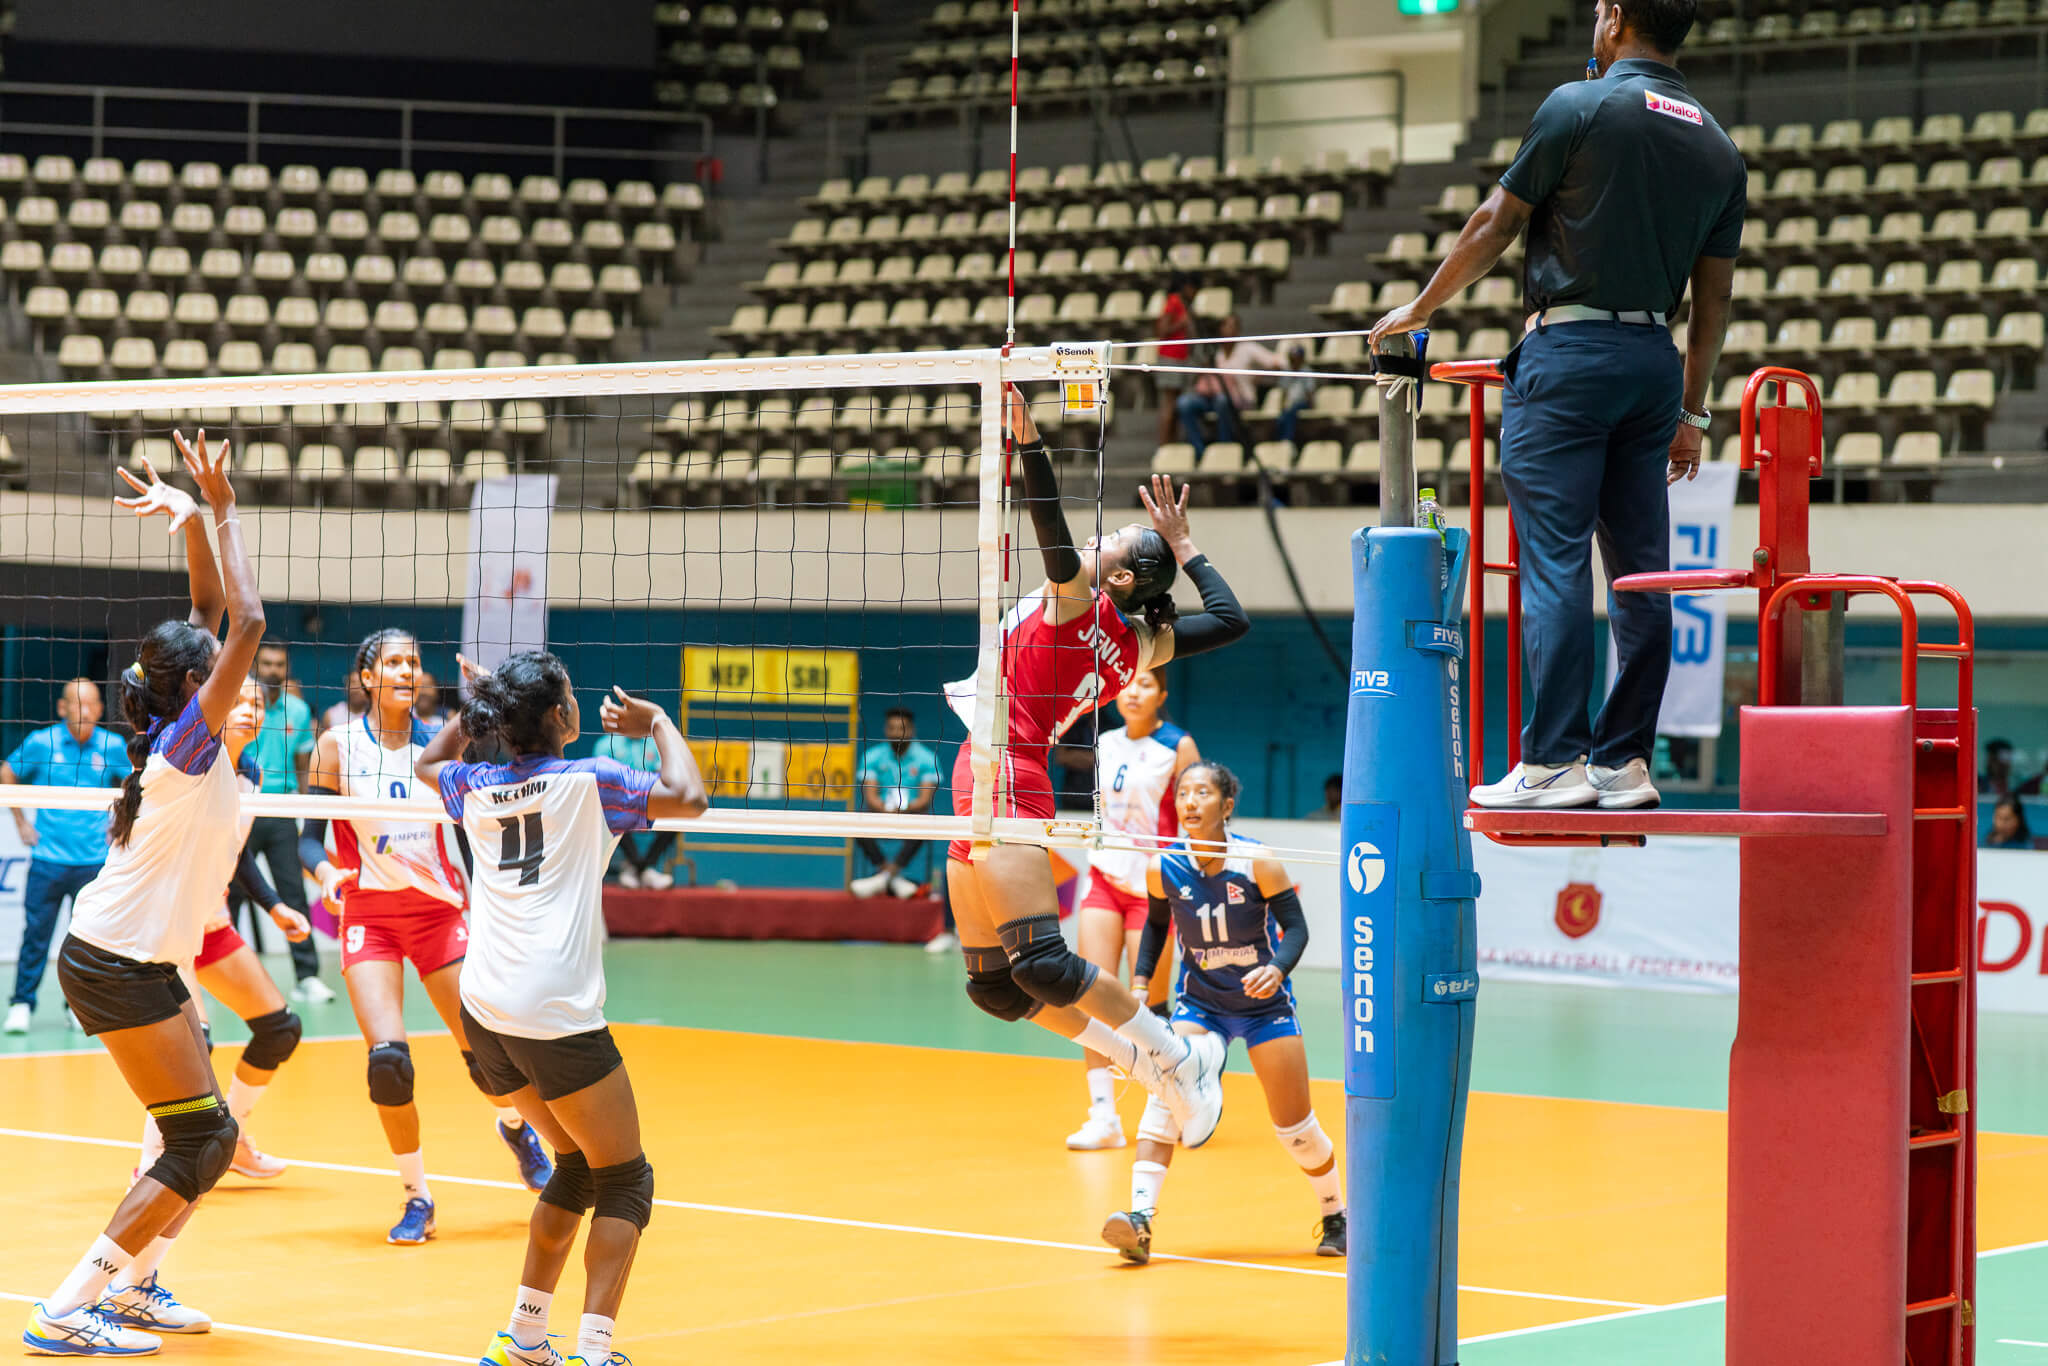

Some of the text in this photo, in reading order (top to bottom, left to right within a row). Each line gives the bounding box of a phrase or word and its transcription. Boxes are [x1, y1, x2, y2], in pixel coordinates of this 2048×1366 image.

[1662, 100, 1703, 124] Dialog
[1064, 347, 1094, 356] Senoh
[1433, 627, 1459, 645] FIVB
[708, 664, 830, 690] NEP SRI
[1354, 670, 1389, 687] FIVB
[1113, 763, 1128, 793] 6
[496, 812, 546, 887] 4
[1196, 902, 1229, 943] 11
[346, 925, 366, 954] 9
[1627, 955, 1739, 978] FEDERATIO
